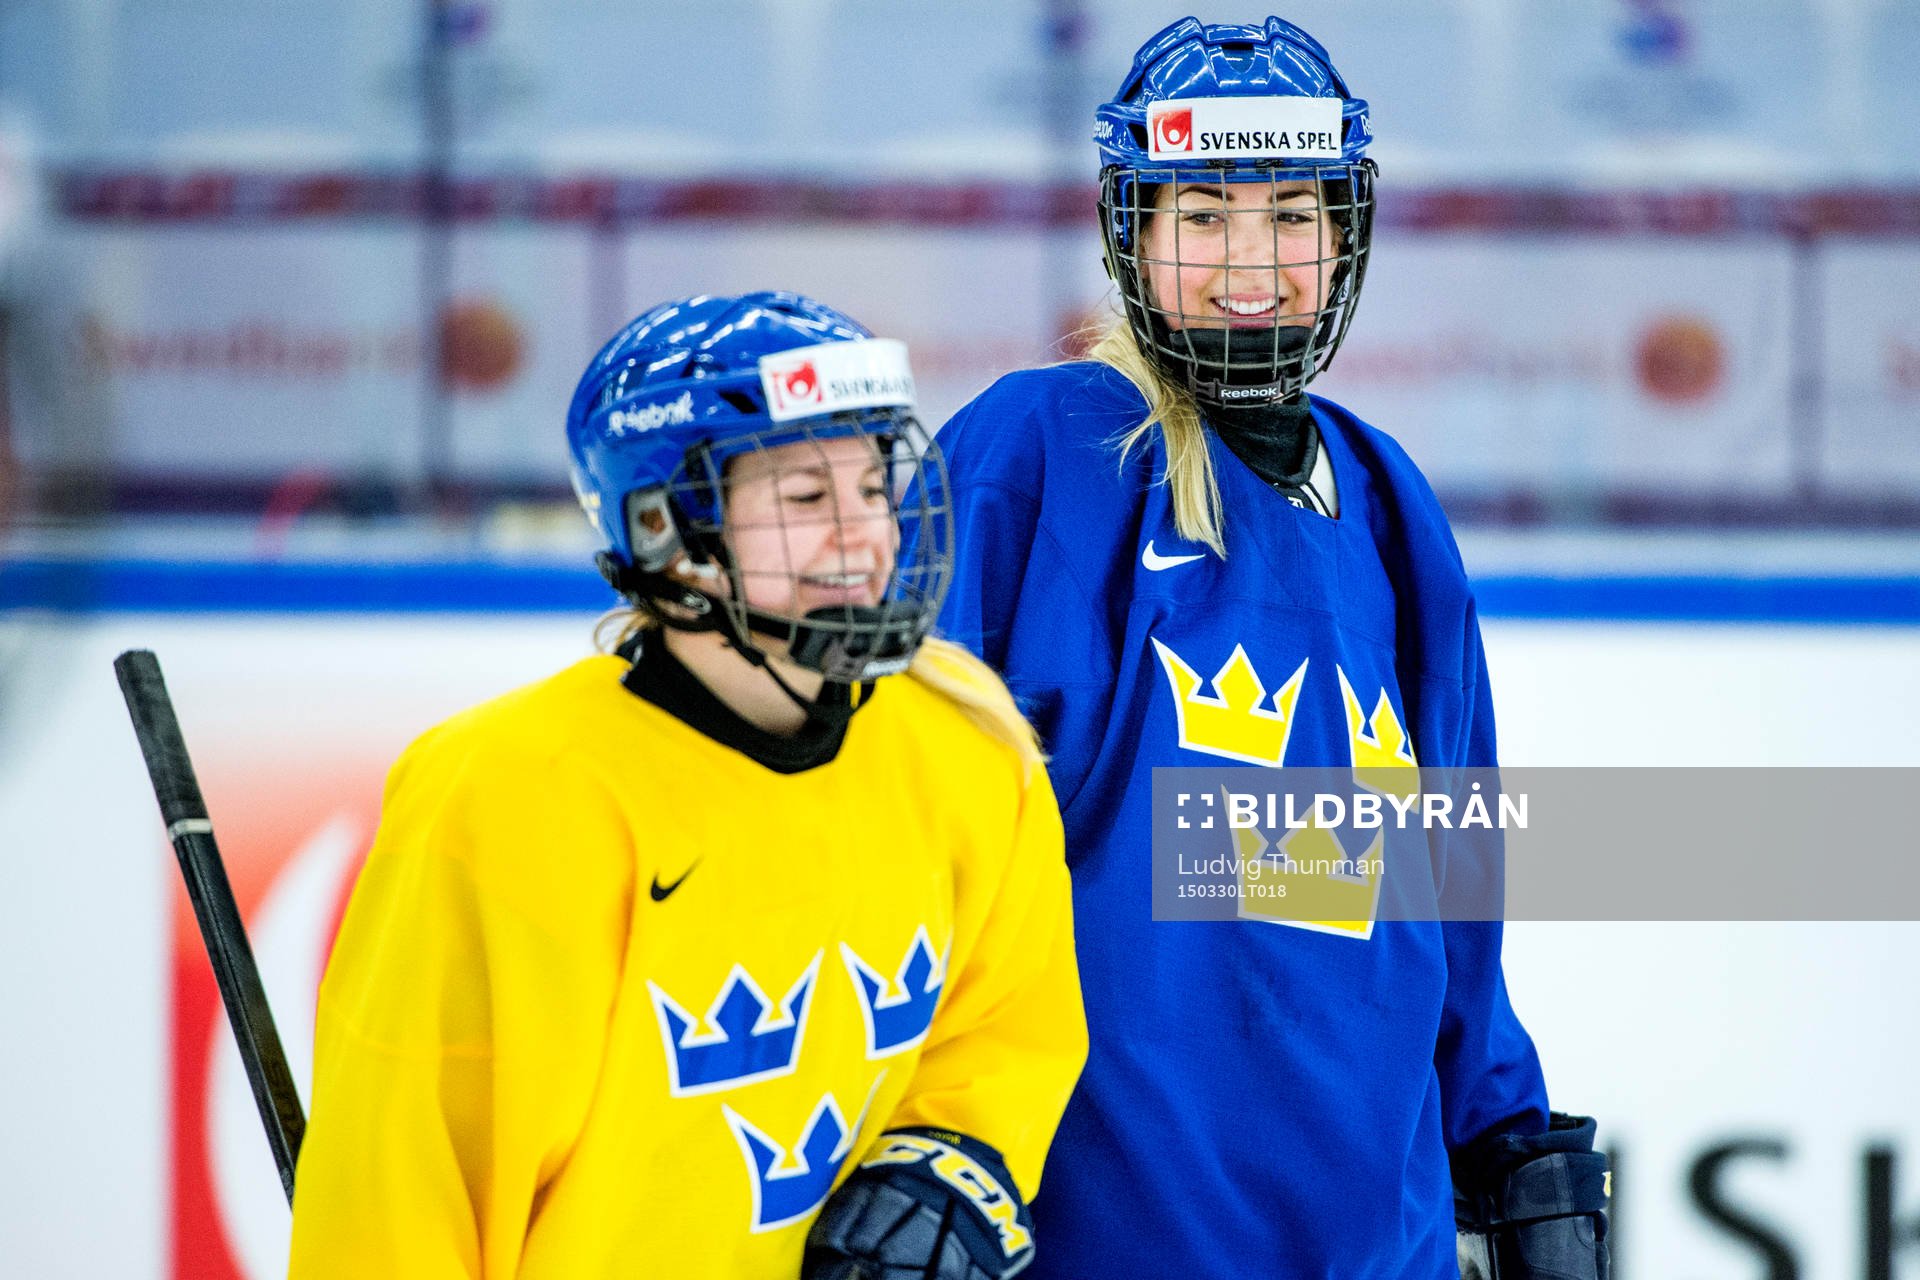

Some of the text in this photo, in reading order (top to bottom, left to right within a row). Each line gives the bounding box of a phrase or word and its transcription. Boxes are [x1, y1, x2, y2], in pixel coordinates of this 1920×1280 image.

[1200, 131, 1338, 151] SVENSKA SPEL
[1220, 386, 1278, 399] Reebok
[861, 1134, 1033, 1258] CCM
